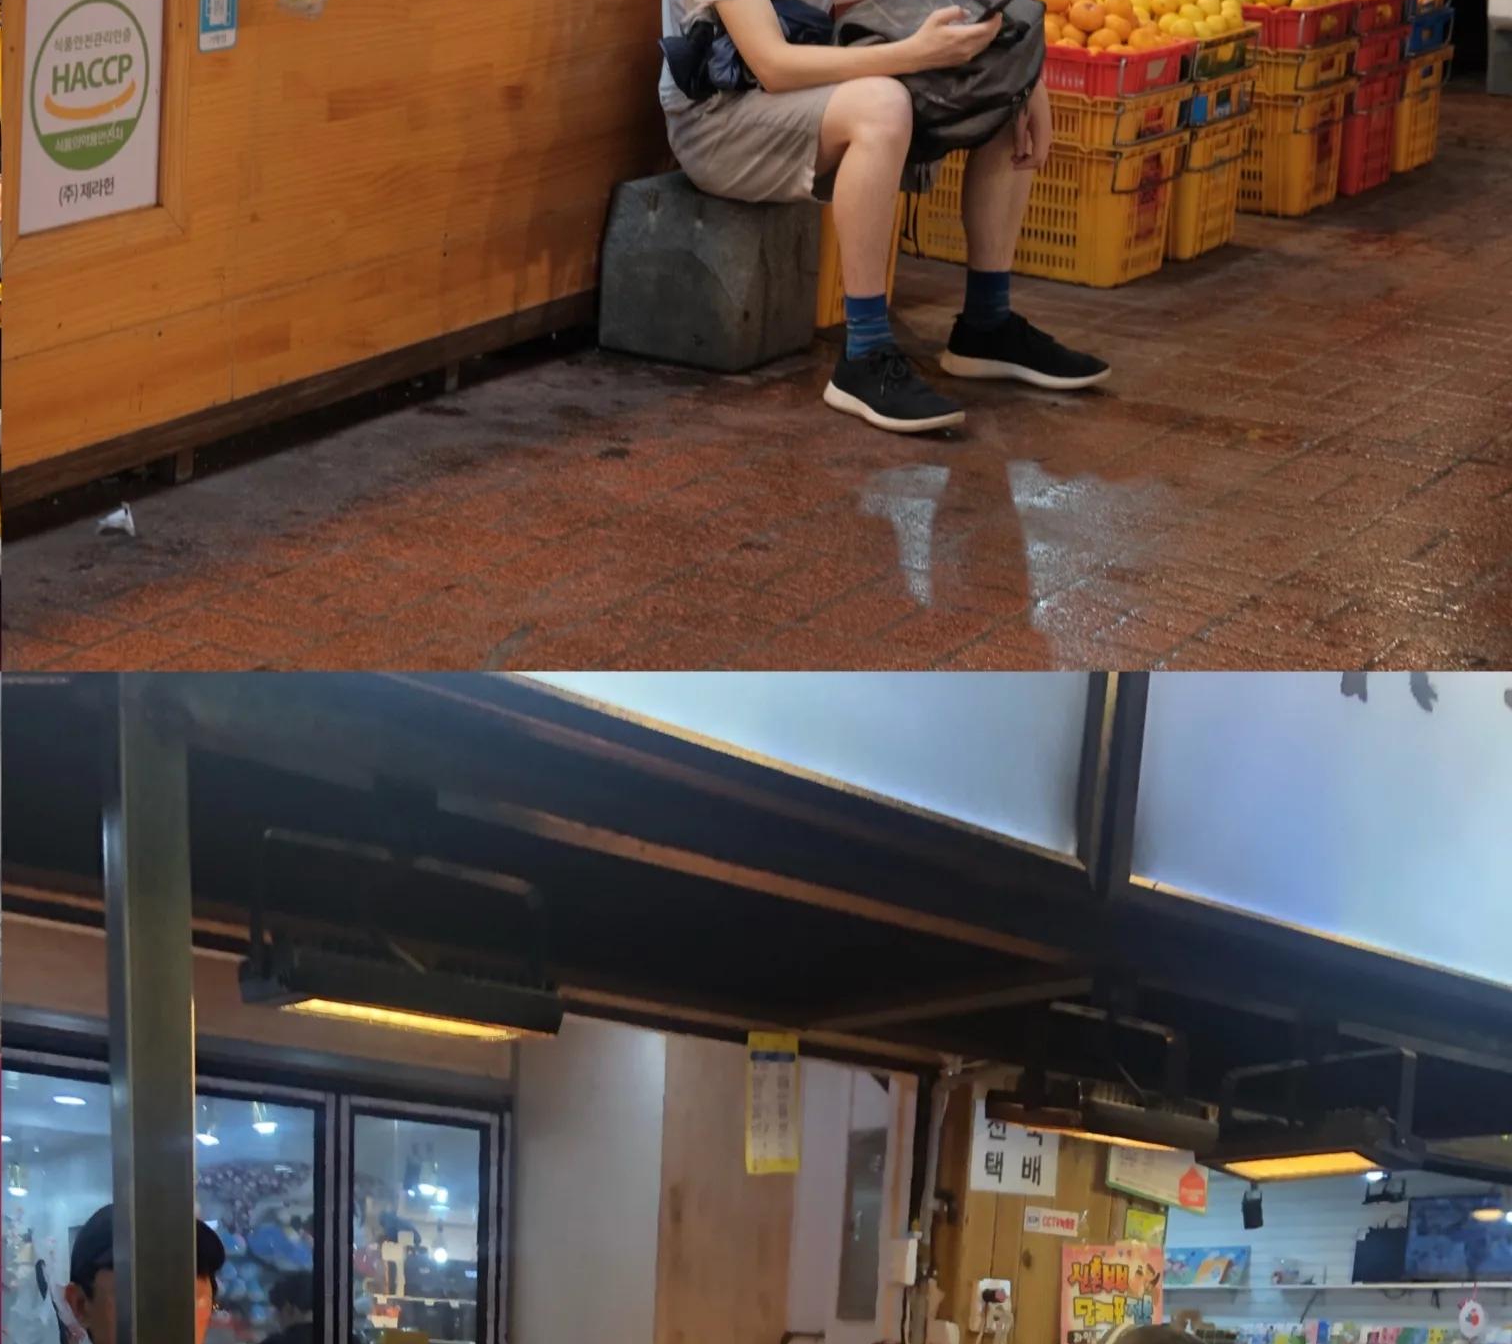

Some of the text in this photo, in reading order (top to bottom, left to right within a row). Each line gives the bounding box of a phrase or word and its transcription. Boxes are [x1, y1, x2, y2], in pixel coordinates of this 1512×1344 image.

[51, 54, 134, 96] HACCP
[984, 1150, 1042, 1187] 택배
[1067, 1254, 1130, 1295] 신혼부부
